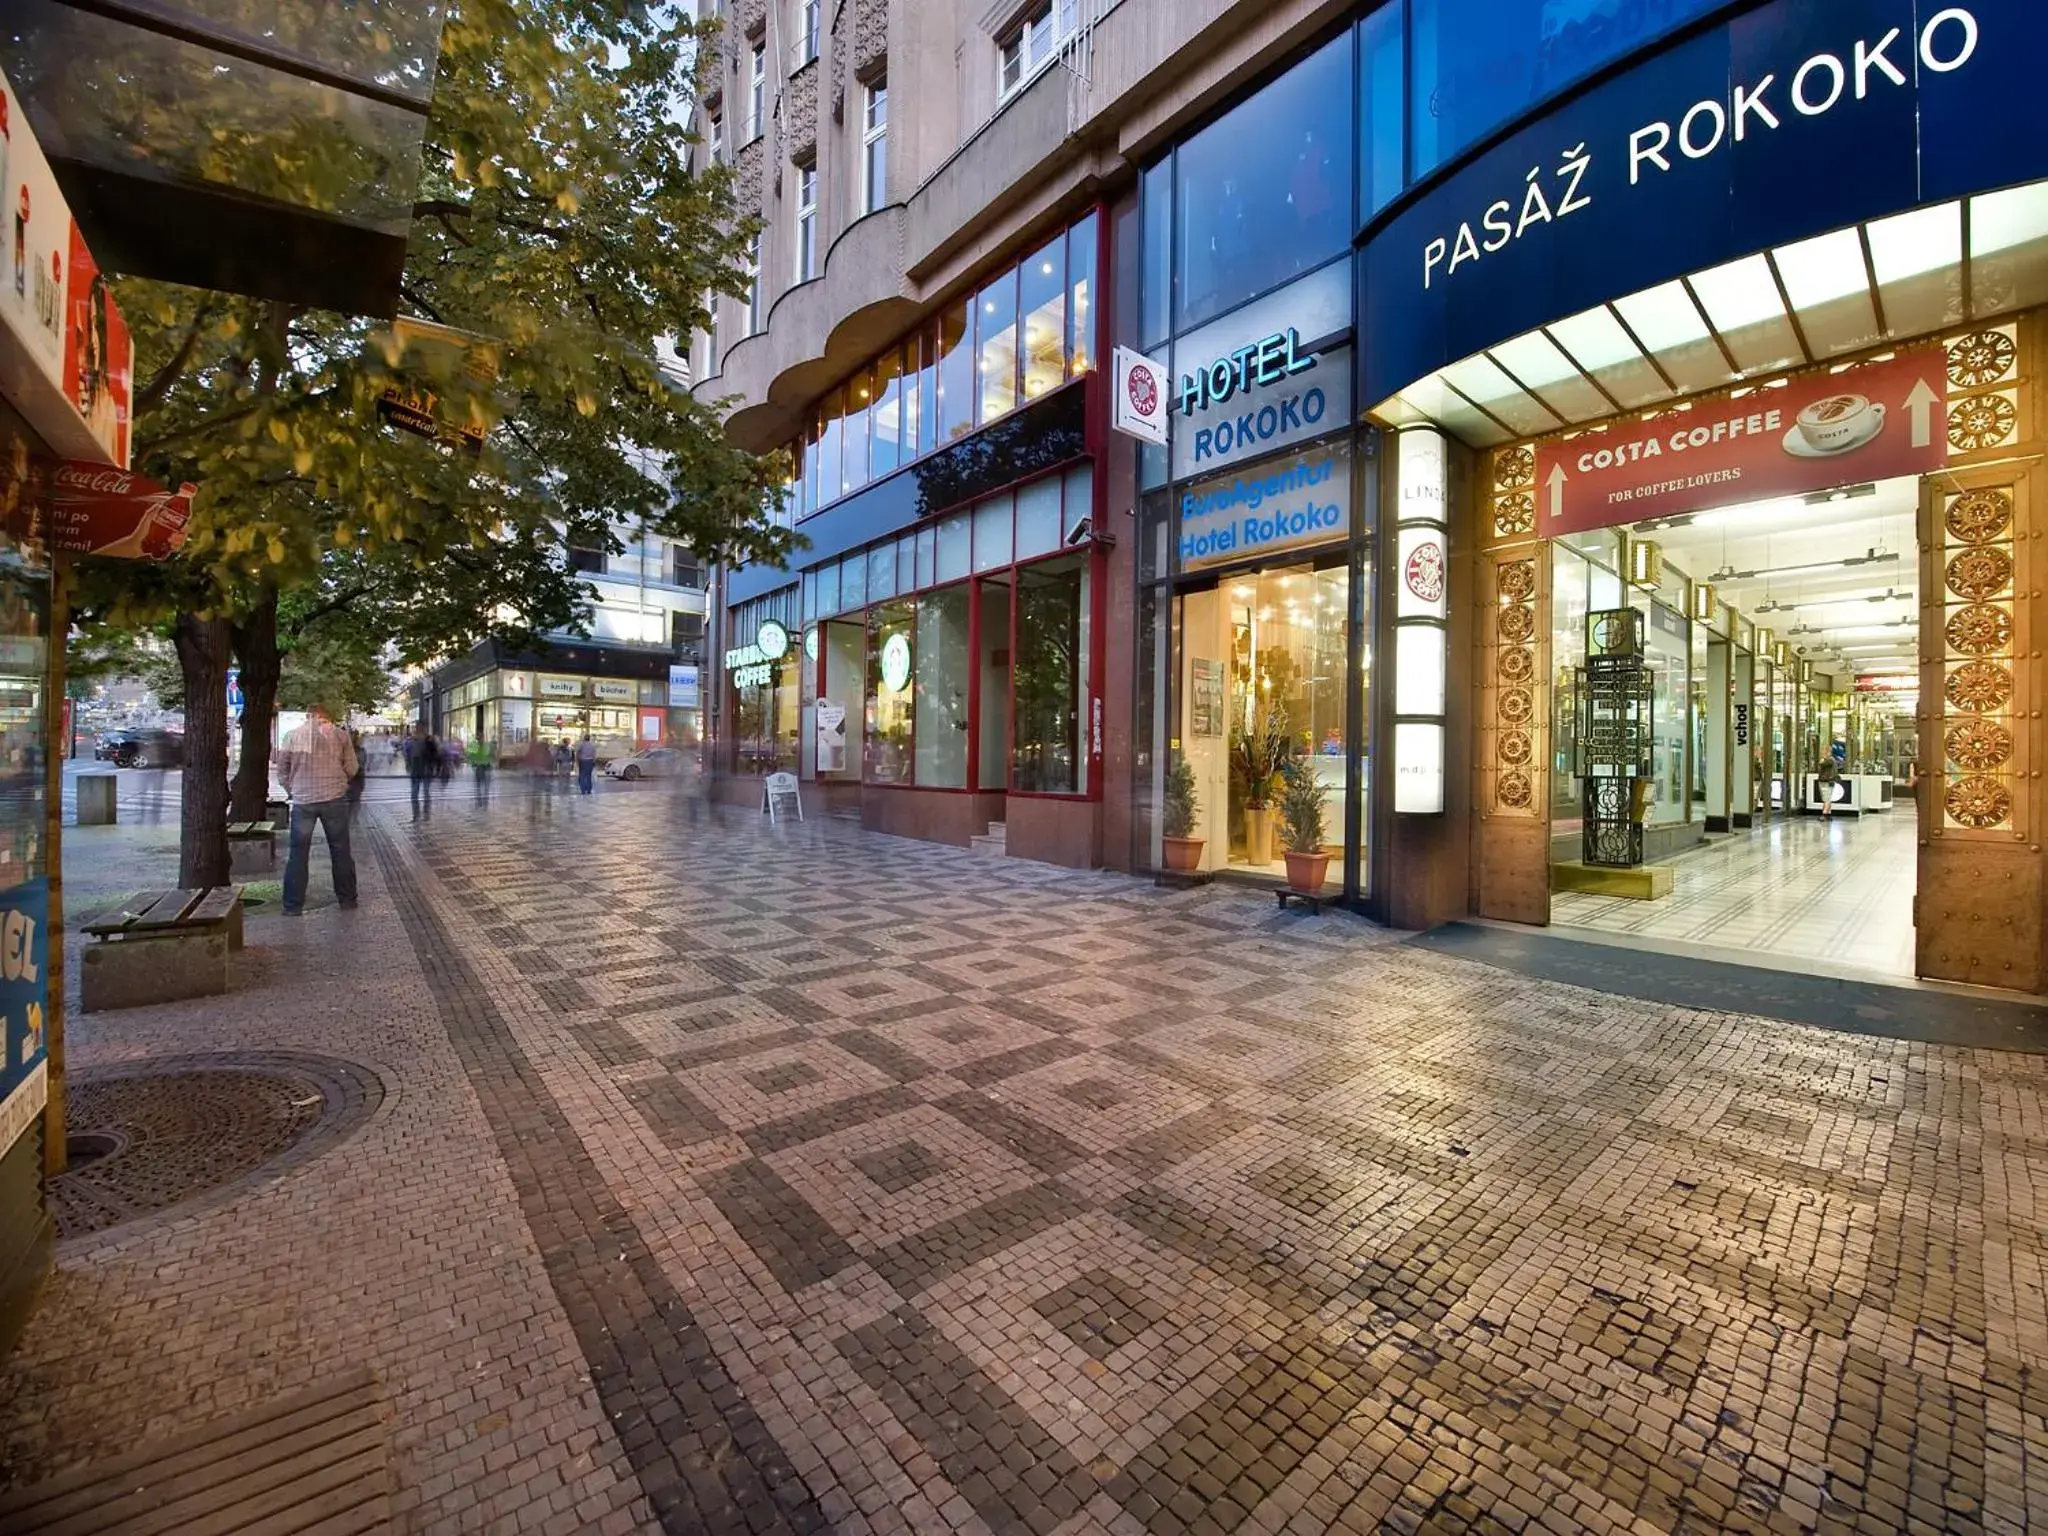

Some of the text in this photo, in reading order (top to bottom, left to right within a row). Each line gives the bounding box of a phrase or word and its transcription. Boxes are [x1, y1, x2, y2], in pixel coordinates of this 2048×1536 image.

[1424, 8, 1978, 288] PASÁŽ ROKOKO
[1182, 328, 1315, 415] HOTEL
[1195, 387, 1325, 461] ROKOKO
[1577, 409, 1782, 473] COSTA COFFEE
[1183, 459, 1334, 520] EuroAgentur
[1608, 467, 1741, 504] FOR COFFEE LOVERS
[1179, 502, 1340, 560] Hotel Rokoko
[550, 682, 574, 693] knihy
[734, 664, 771, 688] COFFEE
[1737, 704, 1748, 747] vchod
